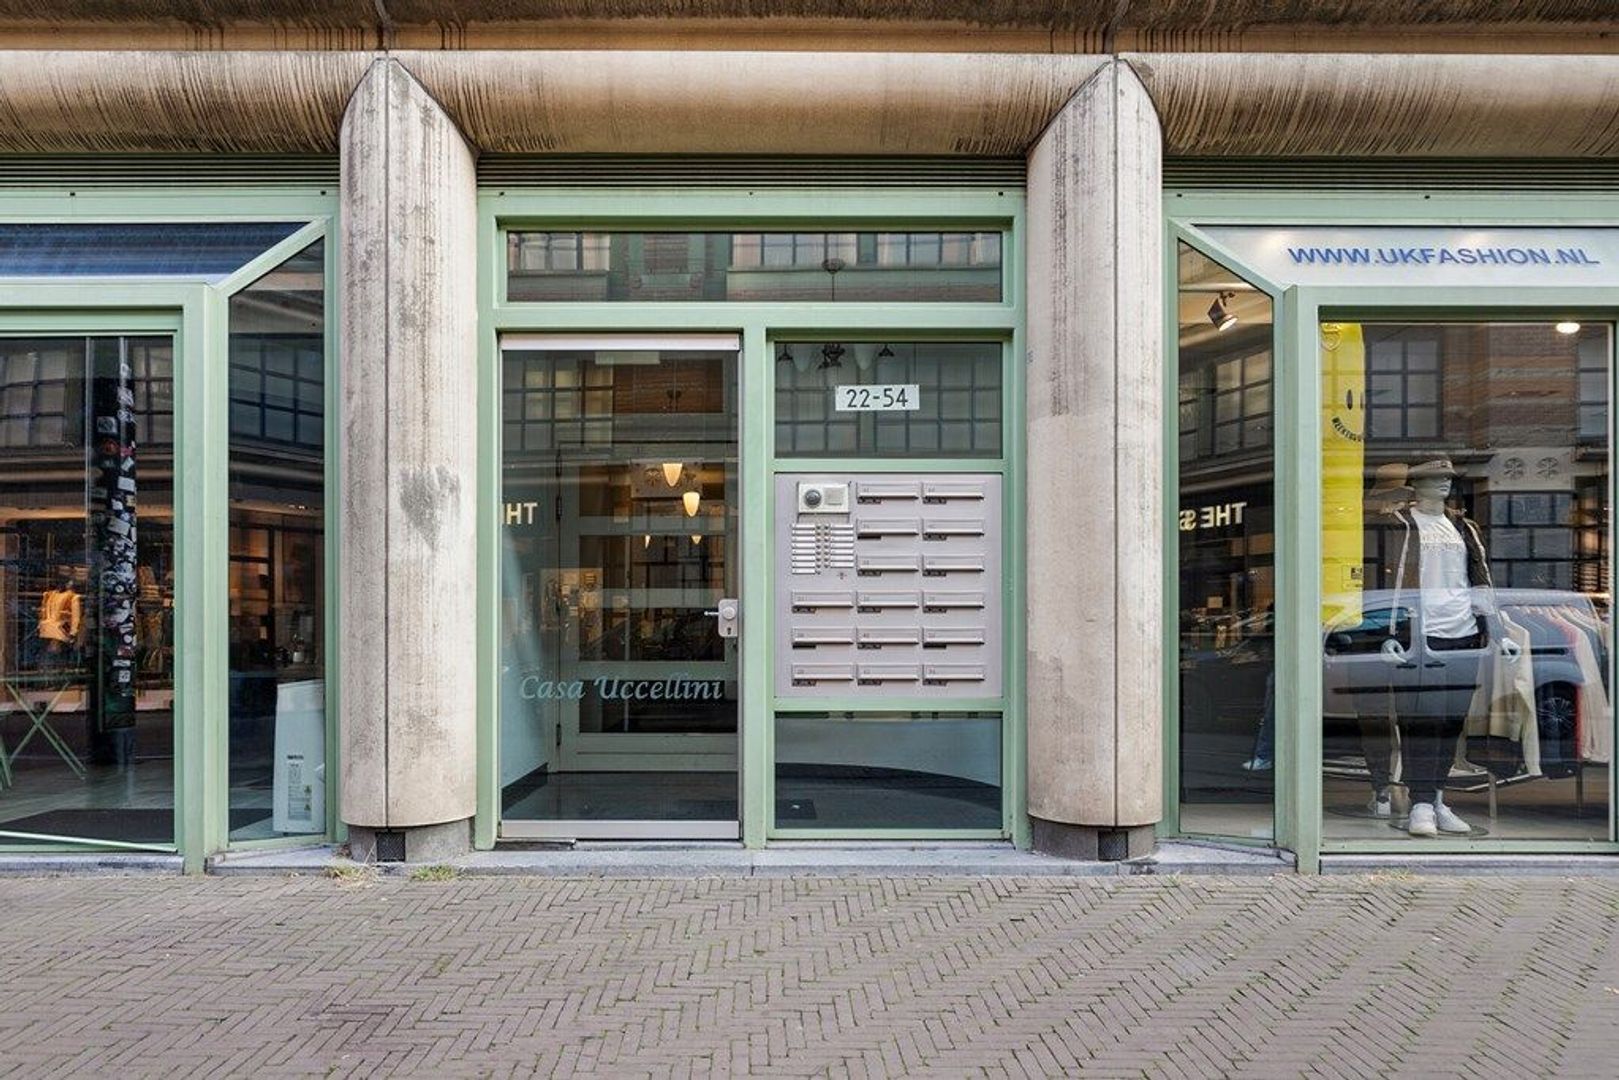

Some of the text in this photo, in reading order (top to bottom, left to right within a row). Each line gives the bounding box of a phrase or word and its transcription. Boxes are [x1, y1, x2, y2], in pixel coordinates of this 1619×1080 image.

[1287, 247, 1600, 266] WWW.UKFASHION.NL
[845, 387, 909, 408] 22-54
[520, 673, 723, 702] Casa Uccellini
